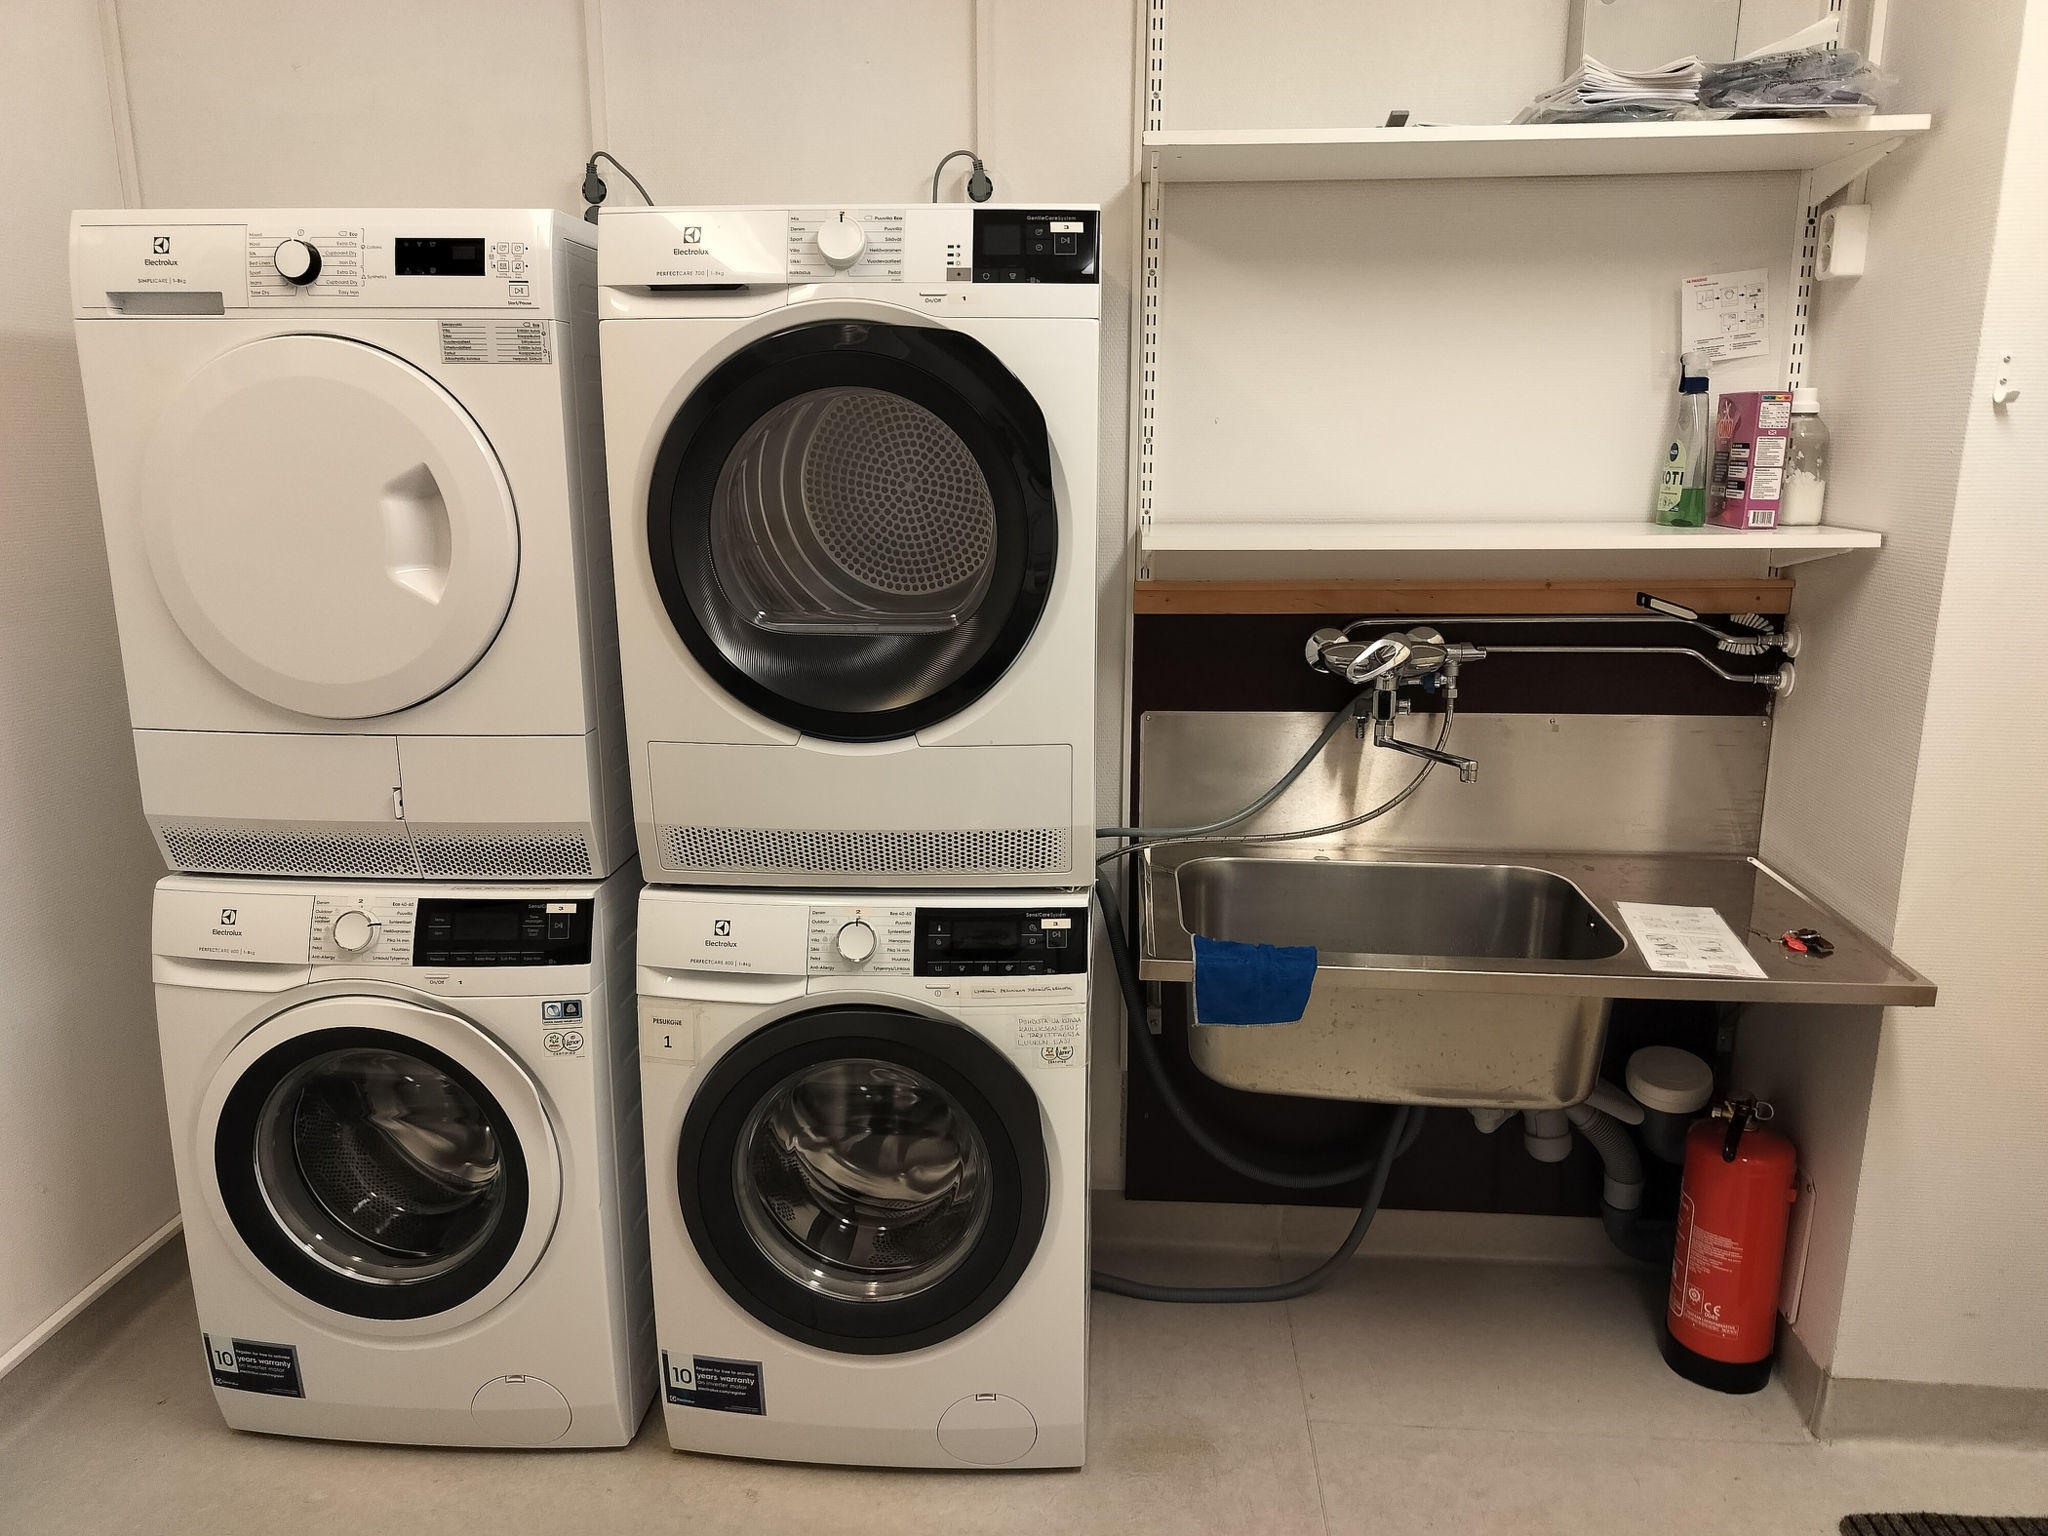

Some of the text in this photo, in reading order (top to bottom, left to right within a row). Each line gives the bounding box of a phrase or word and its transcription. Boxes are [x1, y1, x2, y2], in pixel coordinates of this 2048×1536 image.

[1662, 471, 1684, 485] OTI
[705, 940, 737, 948] Electrolux
[652, 1017, 682, 1026] PESUKONE
[664, 1035, 672, 1048] 1
[1704, 1302, 1721, 1317] CE
[215, 1350, 234, 1366] 10
[258, 1359, 291, 1369] warranty
[673, 1367, 692, 1383] 10
[720, 1376, 755, 1386] warranty
[698, 1387, 746, 1396] electrolux.com/register
